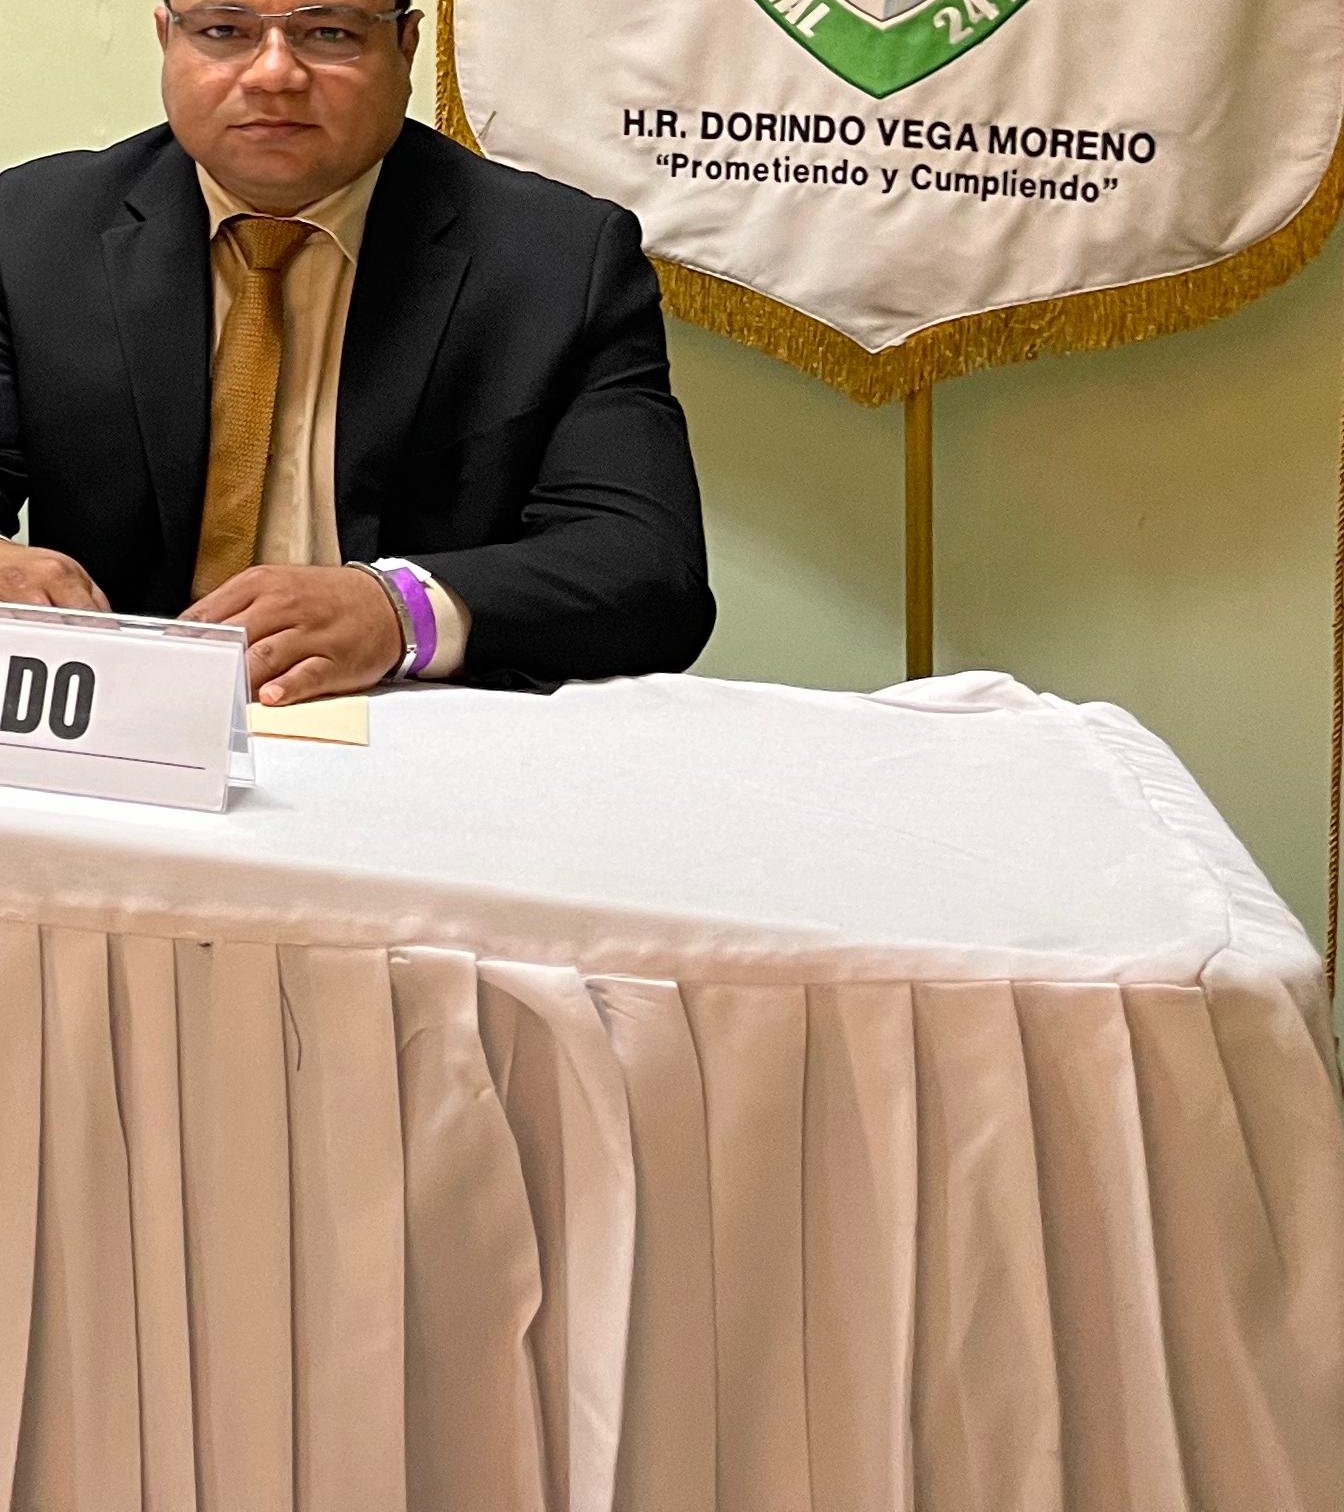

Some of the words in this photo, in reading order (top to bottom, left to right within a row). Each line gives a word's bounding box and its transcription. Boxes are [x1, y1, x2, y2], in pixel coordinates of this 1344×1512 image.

[623, 109, 687, 139] H.R.
[700, 111, 866, 146] DORINDO
[876, 117, 979, 152] VEGA
[988, 125, 1156, 164] MORENO
[880, 168, 898, 194] y
